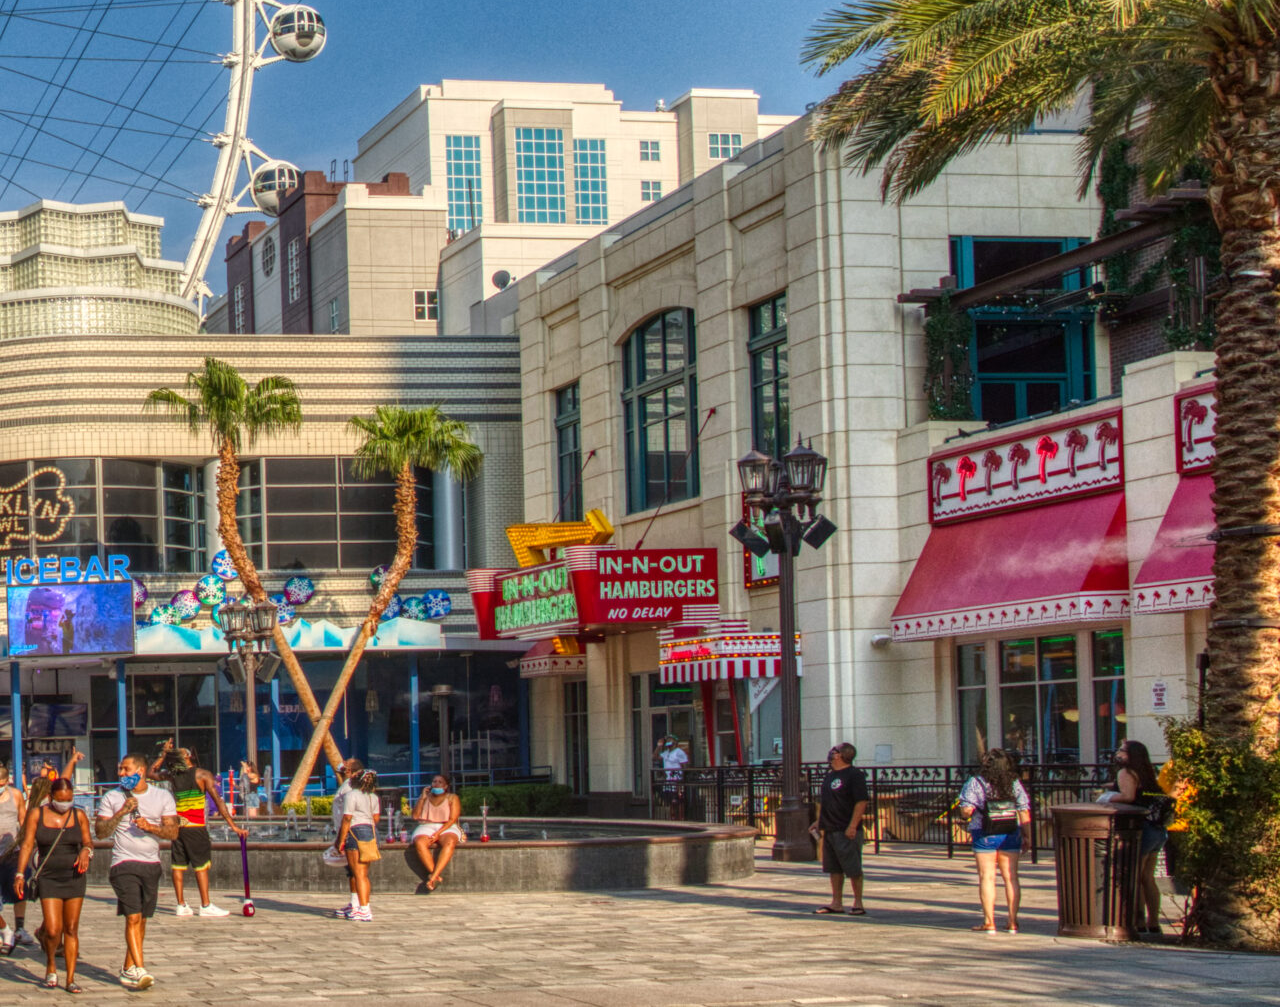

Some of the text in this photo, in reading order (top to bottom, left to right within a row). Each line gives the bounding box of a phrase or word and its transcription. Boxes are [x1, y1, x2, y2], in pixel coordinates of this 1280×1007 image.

[6, 554, 132, 585] ICEBAR
[599, 554, 705, 575] IN-N-OUT
[502, 567, 568, 601] IN-N-OUT
[599, 579, 716, 600] HAMBURGERS
[607, 606, 673, 619] NO DELAY
